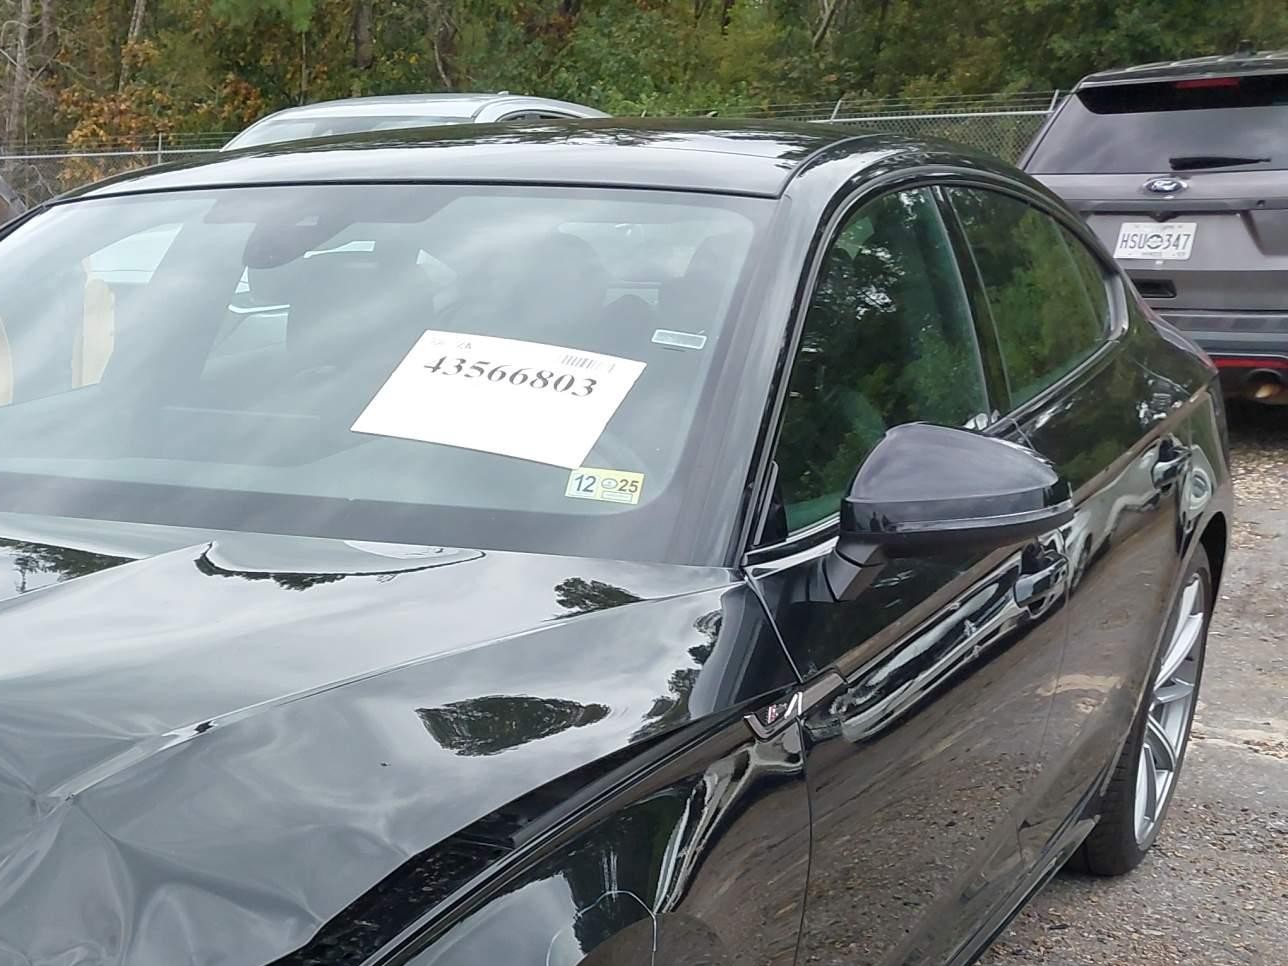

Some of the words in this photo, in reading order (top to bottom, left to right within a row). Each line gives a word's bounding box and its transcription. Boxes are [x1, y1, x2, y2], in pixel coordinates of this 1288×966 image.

[1163, 233, 1191, 250] 347
[423, 355, 599, 398] 43566803
[574, 474, 597, 493] 12
[617, 478, 639, 493] 25
